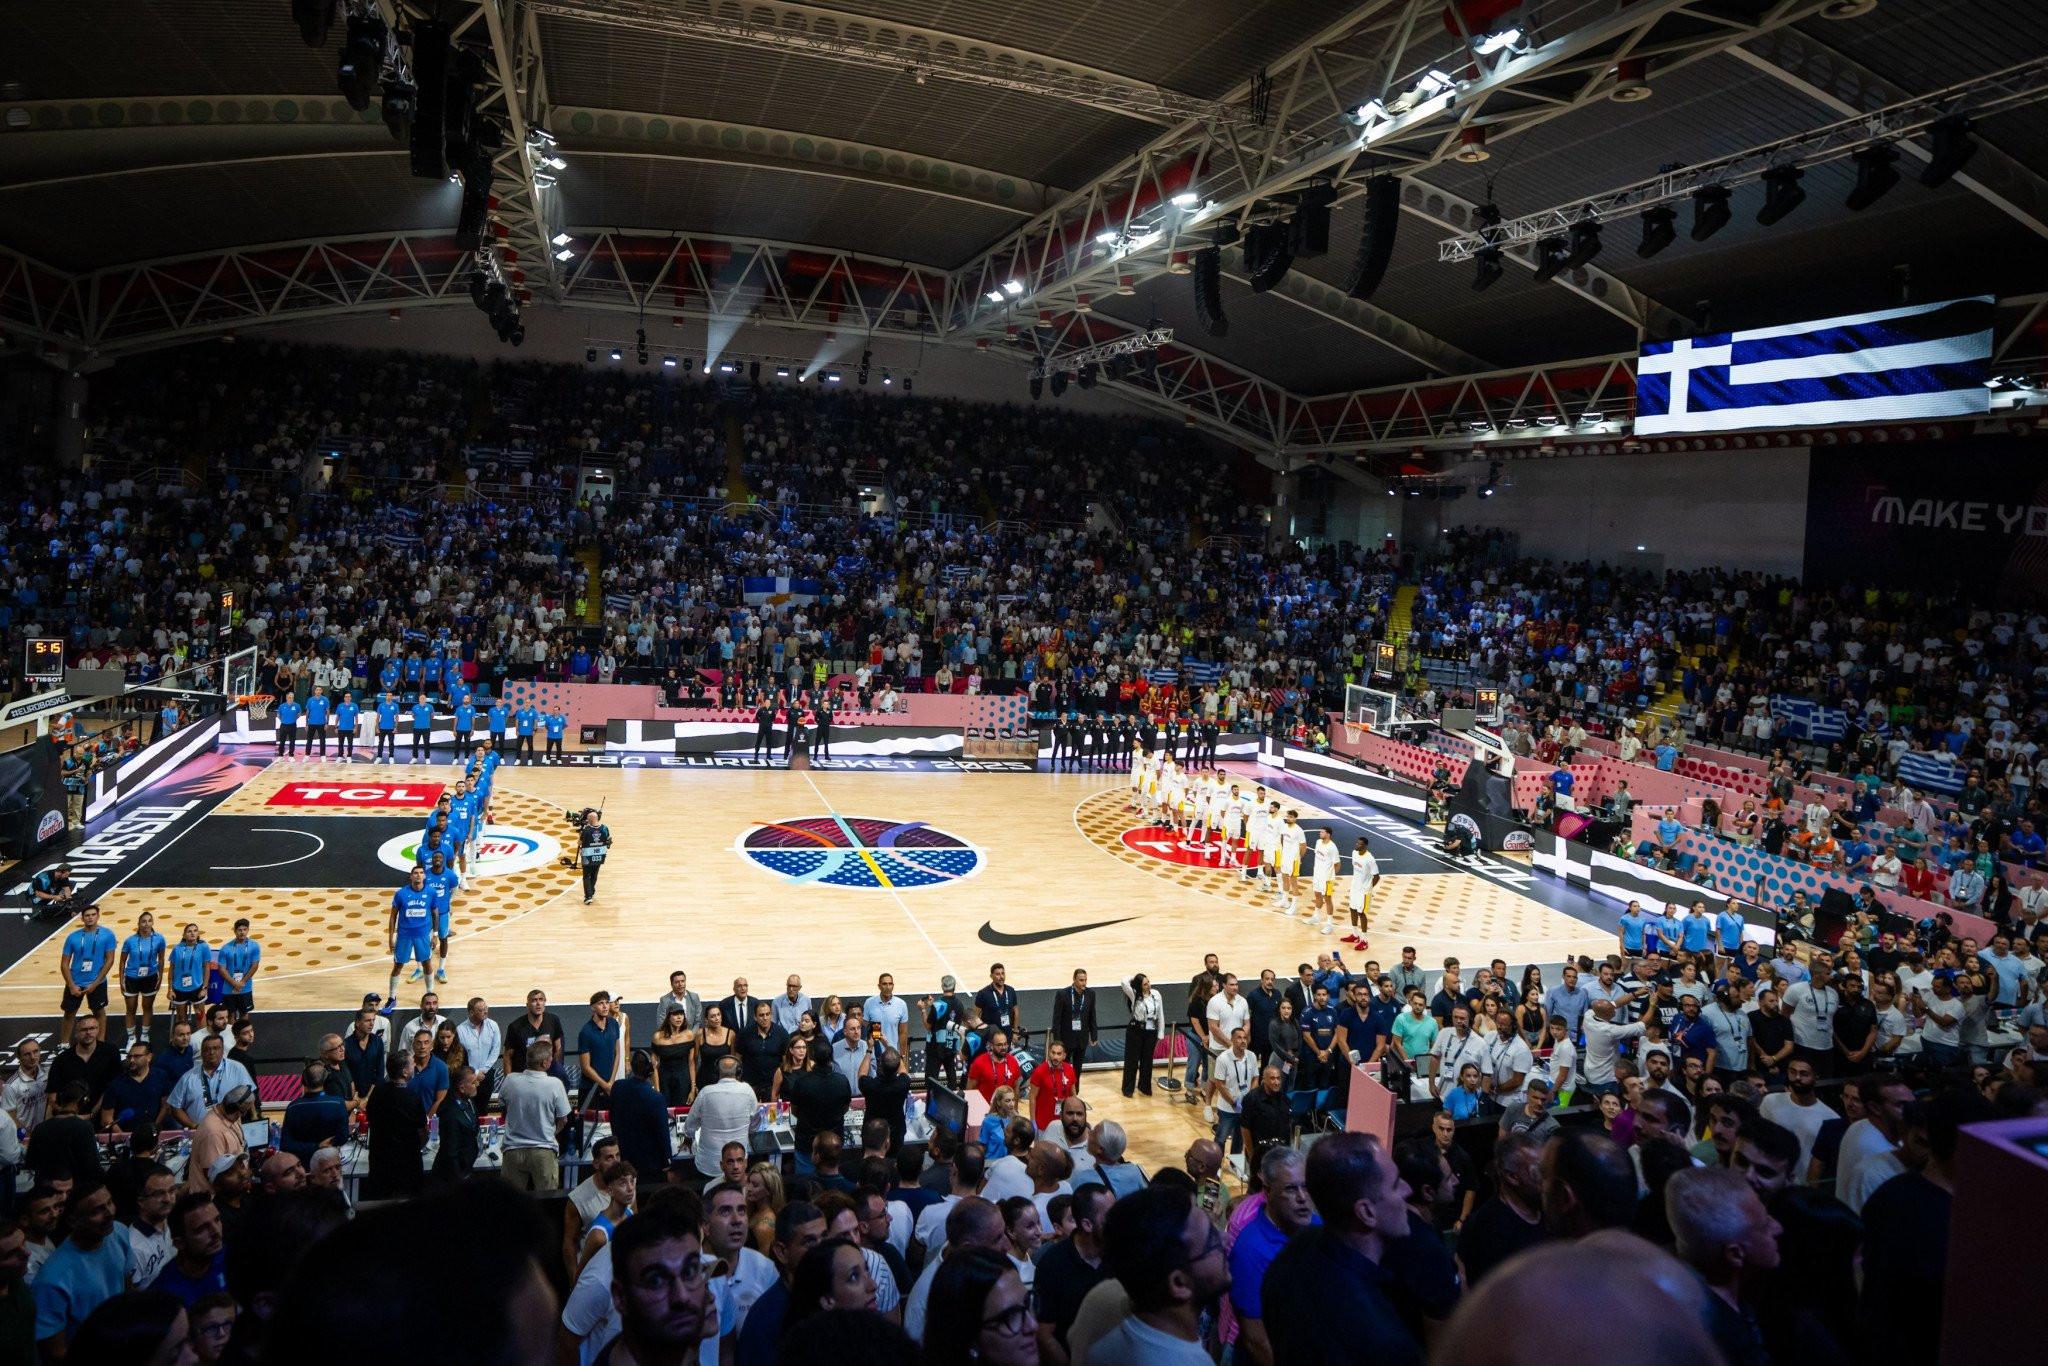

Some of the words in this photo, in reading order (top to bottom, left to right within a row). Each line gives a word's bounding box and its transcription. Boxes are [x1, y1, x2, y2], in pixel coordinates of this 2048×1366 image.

[1871, 496, 1988, 531] MAKE
[11, 695, 71, 717] #EUROBASKET
[931, 760, 1033, 771] 2025
[294, 788, 426, 800] TCL
